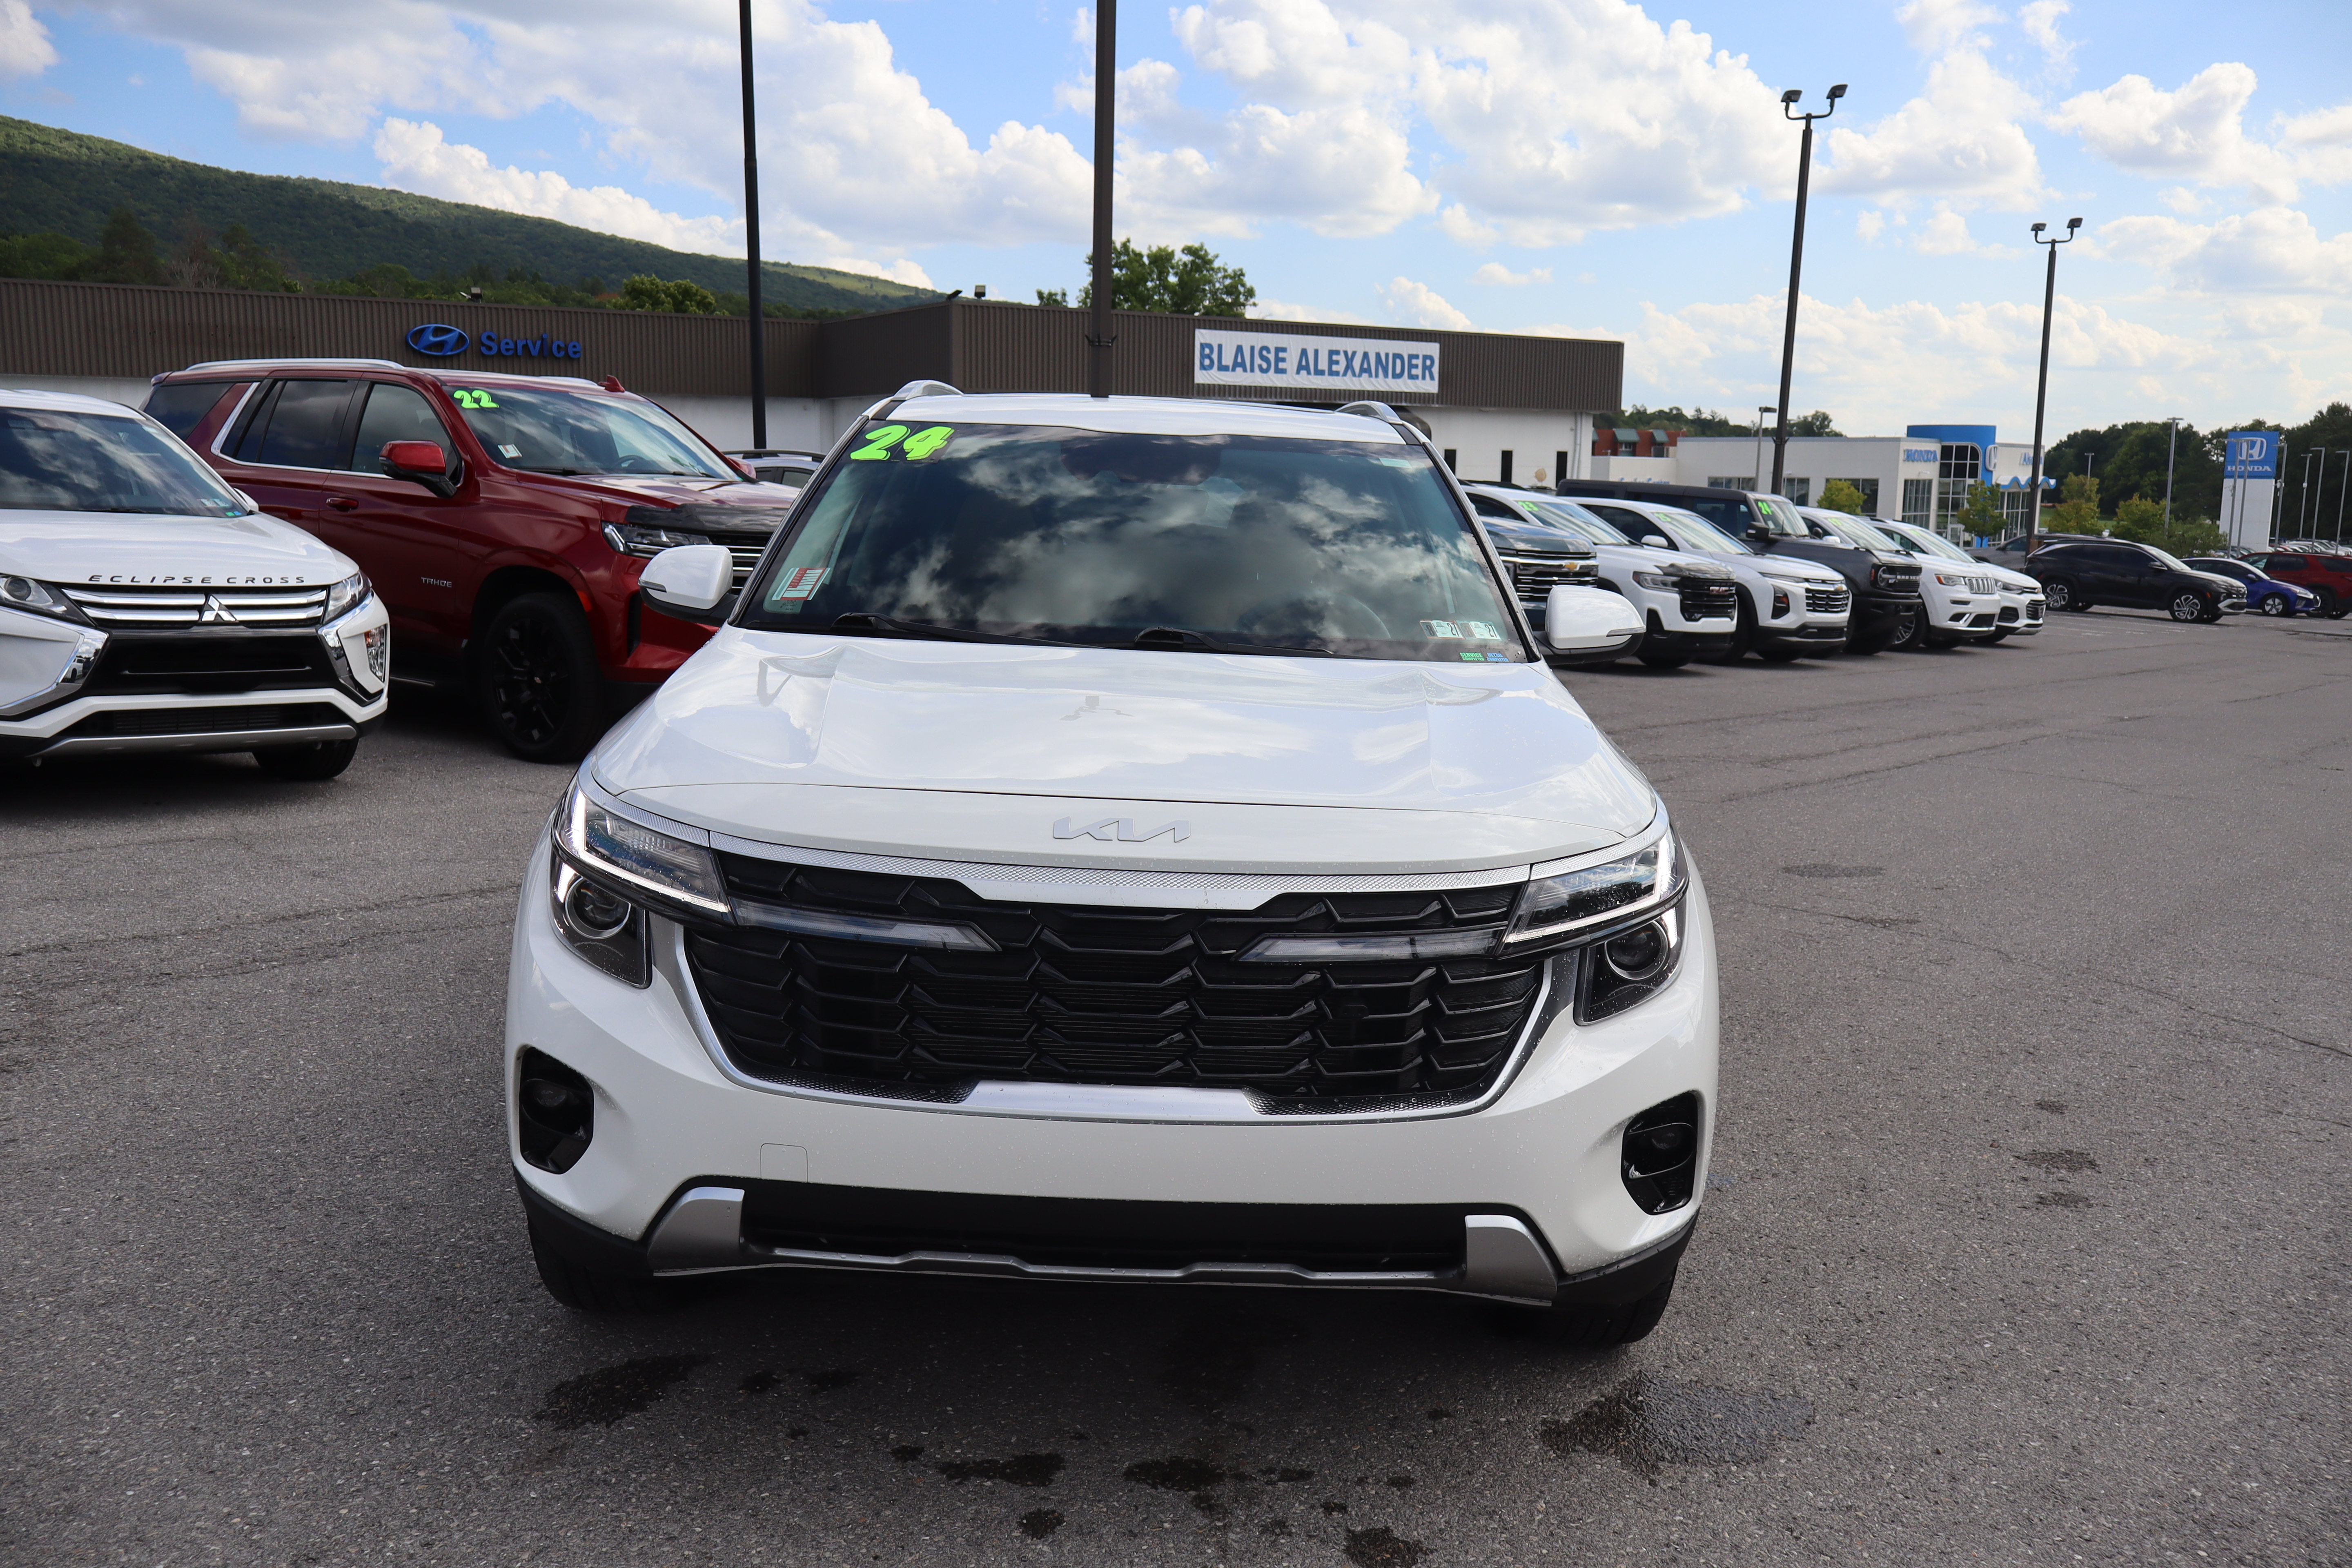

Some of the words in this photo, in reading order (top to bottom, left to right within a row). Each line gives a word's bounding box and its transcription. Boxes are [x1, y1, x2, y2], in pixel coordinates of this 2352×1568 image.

[480, 331, 582, 359] Service
[1199, 343, 1287, 374] BLAISE
[1296, 348, 1435, 381] ALEXANDER
[453, 389, 500, 408] 22
[850, 425, 955, 461] 24
[1904, 449, 1939, 461] HONDA
[1517, 501, 1539, 511] 23
[88, 575, 212, 584] ECLIPSE
[421, 577, 452, 588] TAHOE
[1447, 622, 1459, 637] 27
[1484, 624, 1497, 638] 27
[1053, 815, 1191, 843] KIA
